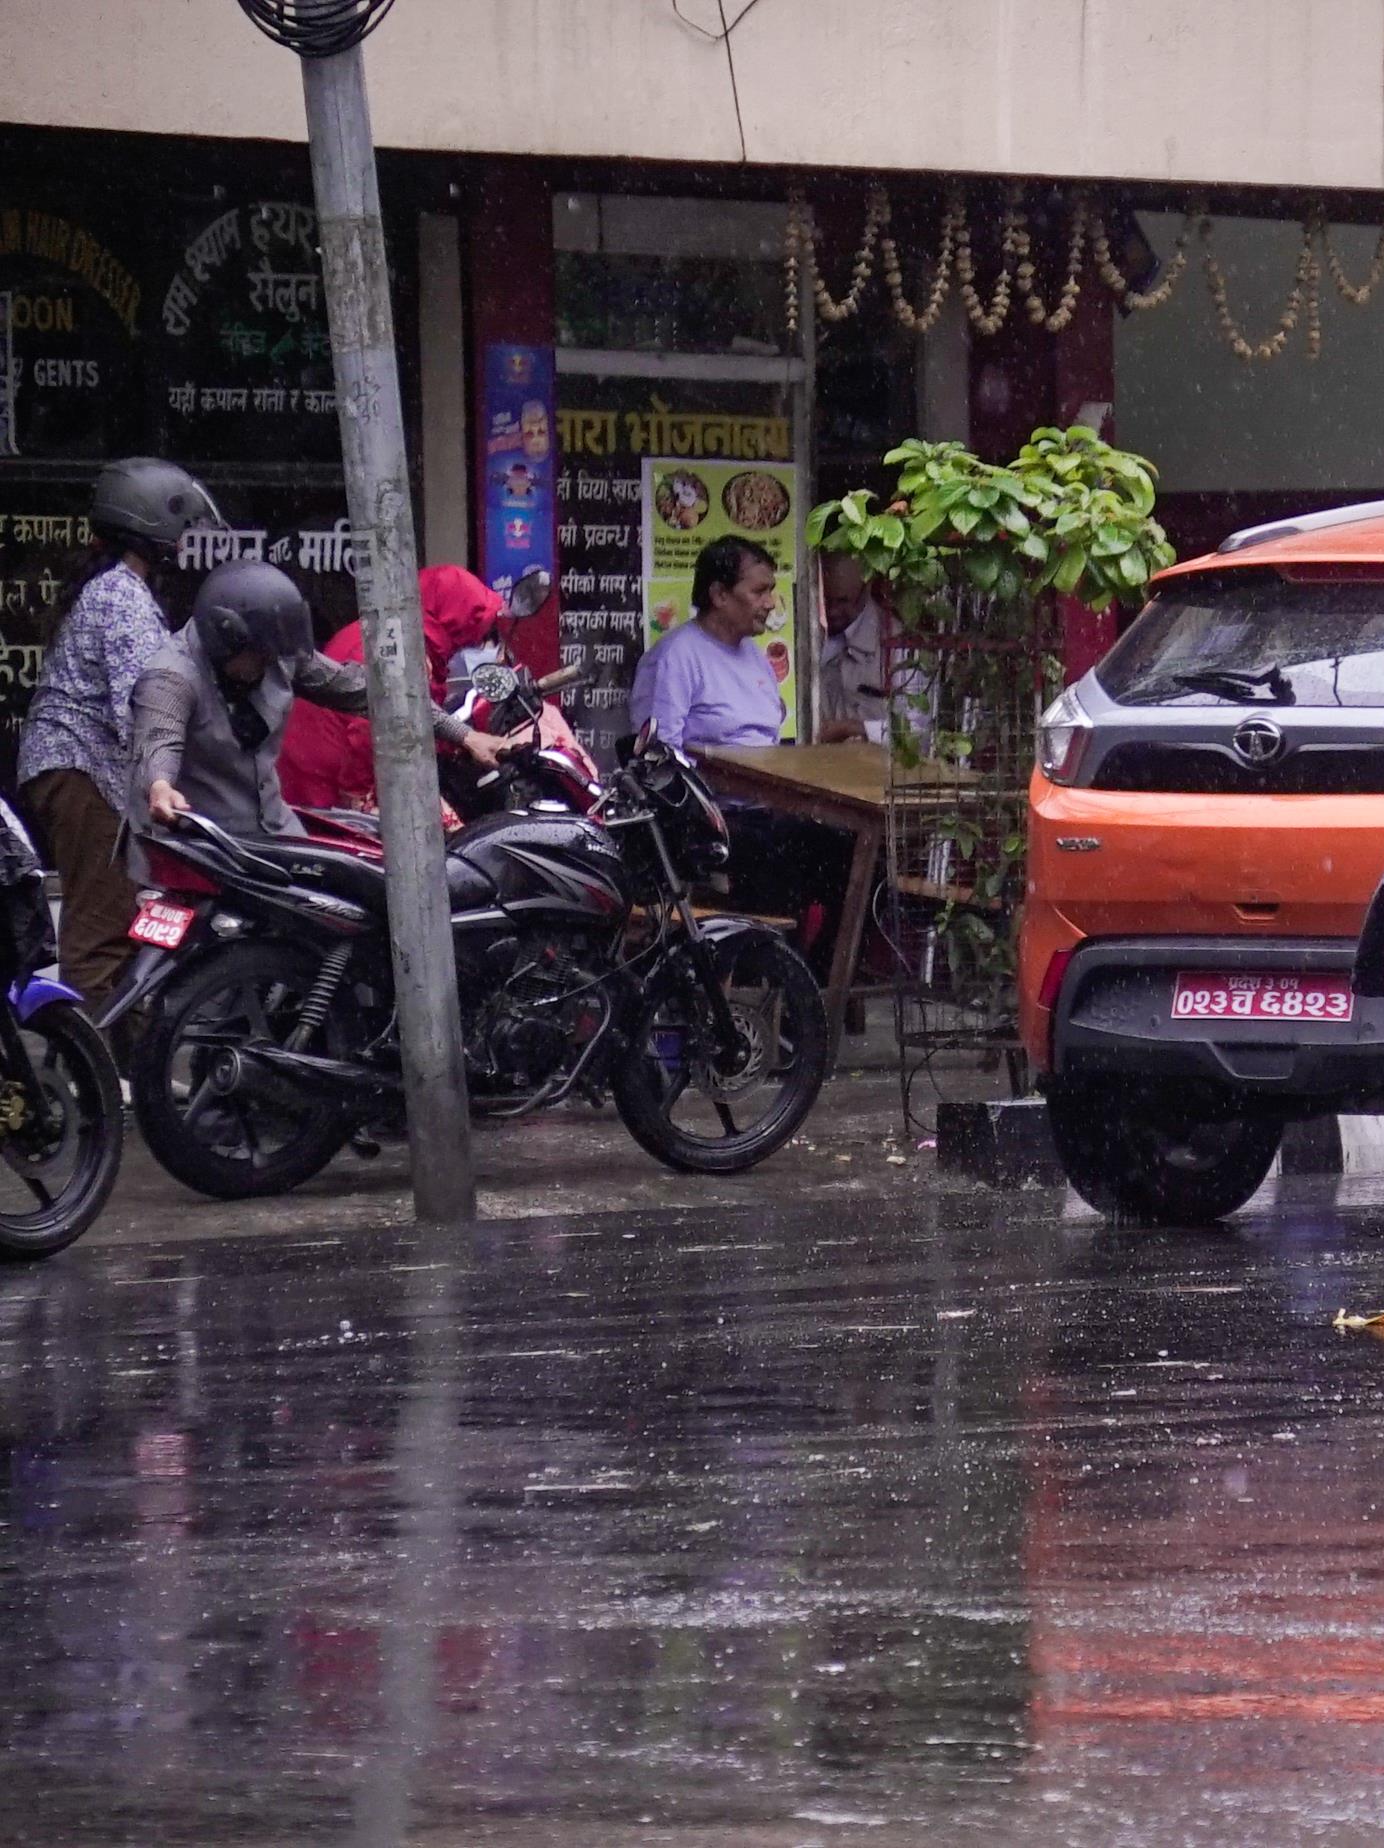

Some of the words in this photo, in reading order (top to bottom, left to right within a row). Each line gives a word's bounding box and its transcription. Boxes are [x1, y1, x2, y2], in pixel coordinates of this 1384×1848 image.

[34, 359, 99, 388] GENTS
[624, 394, 790, 459] भोजनालय
[13, 515, 72, 548] कपाल
